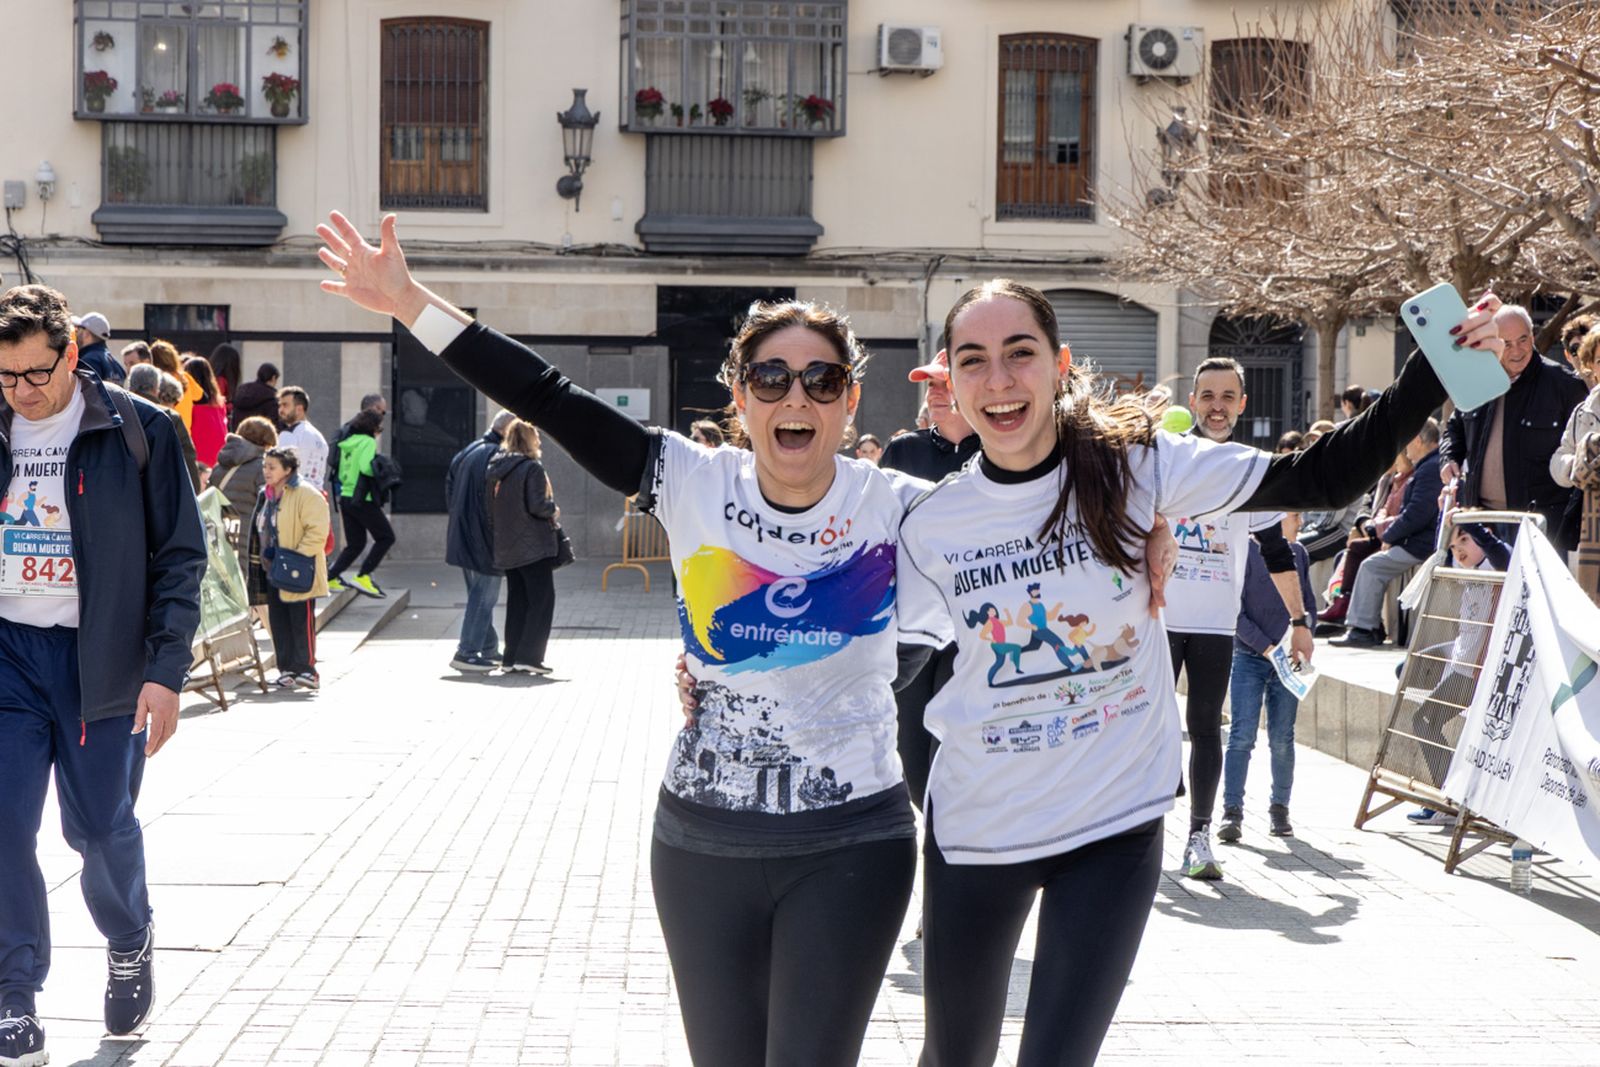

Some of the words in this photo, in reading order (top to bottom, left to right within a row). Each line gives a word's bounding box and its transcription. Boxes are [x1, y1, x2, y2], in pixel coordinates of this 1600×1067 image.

[24, 462, 66, 477] MUERT
[13, 542, 37, 553] BUENA
[39, 543, 70, 555] MUERTE
[944, 551, 958, 565] VI
[963, 536, 1035, 563] CARRERA
[22, 556, 74, 582] 842
[954, 563, 1007, 597] BUENA
[730, 622, 842, 646] entrénate
[1001, 695, 1035, 708] beneficio
